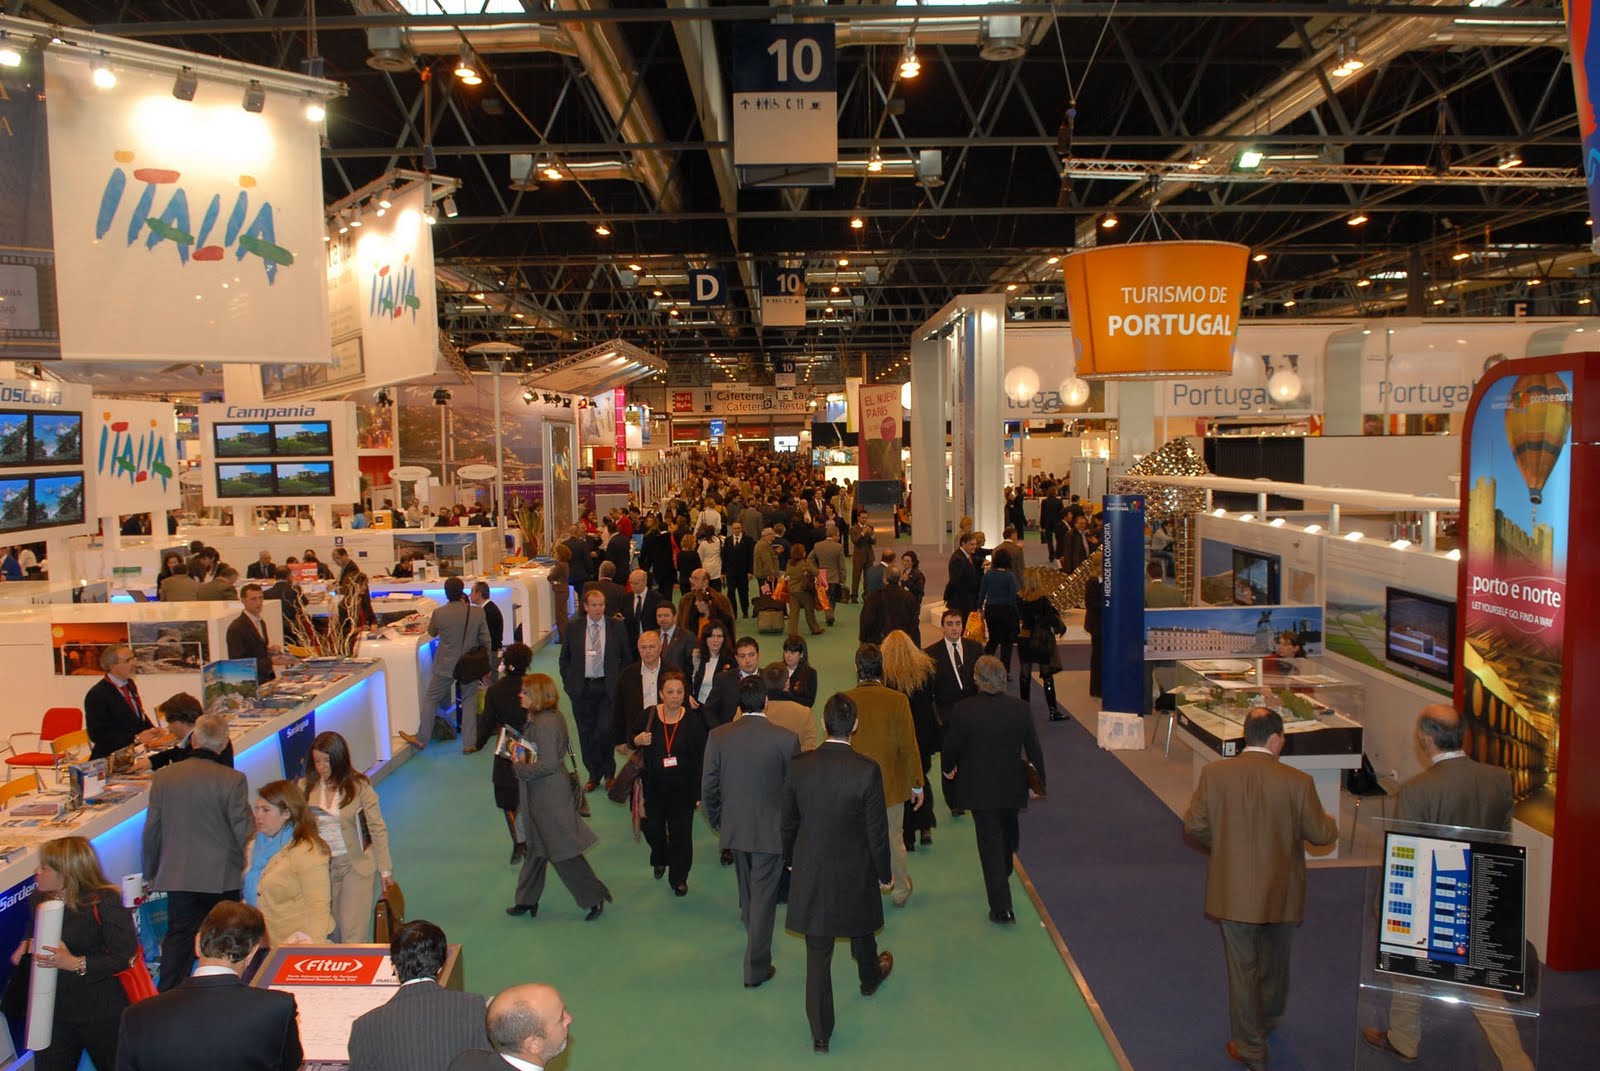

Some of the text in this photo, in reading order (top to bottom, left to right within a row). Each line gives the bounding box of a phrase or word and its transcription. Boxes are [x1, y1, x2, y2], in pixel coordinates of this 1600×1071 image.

[767, 38, 822, 82] 10
[696, 274, 720, 301] D
[776, 274, 800, 293] 10
[1121, 286, 1227, 304] TURISMO DE
[1108, 313, 1231, 336] PORTUGAL
[782, 363, 793, 372] 10
[0, 383, 62, 405] oscana
[864, 396, 875, 406] EL
[226, 404, 315, 420] Campania
[1104, 557, 1111, 567] DA
[1473, 576, 1561, 608] porto e norte
[1472, 600, 1481, 610] LET
[1480, 602, 1508, 617] YOURSELF
[1520, 611, 1534, 623] FIND
[306, 960, 352, 972] Fitur
